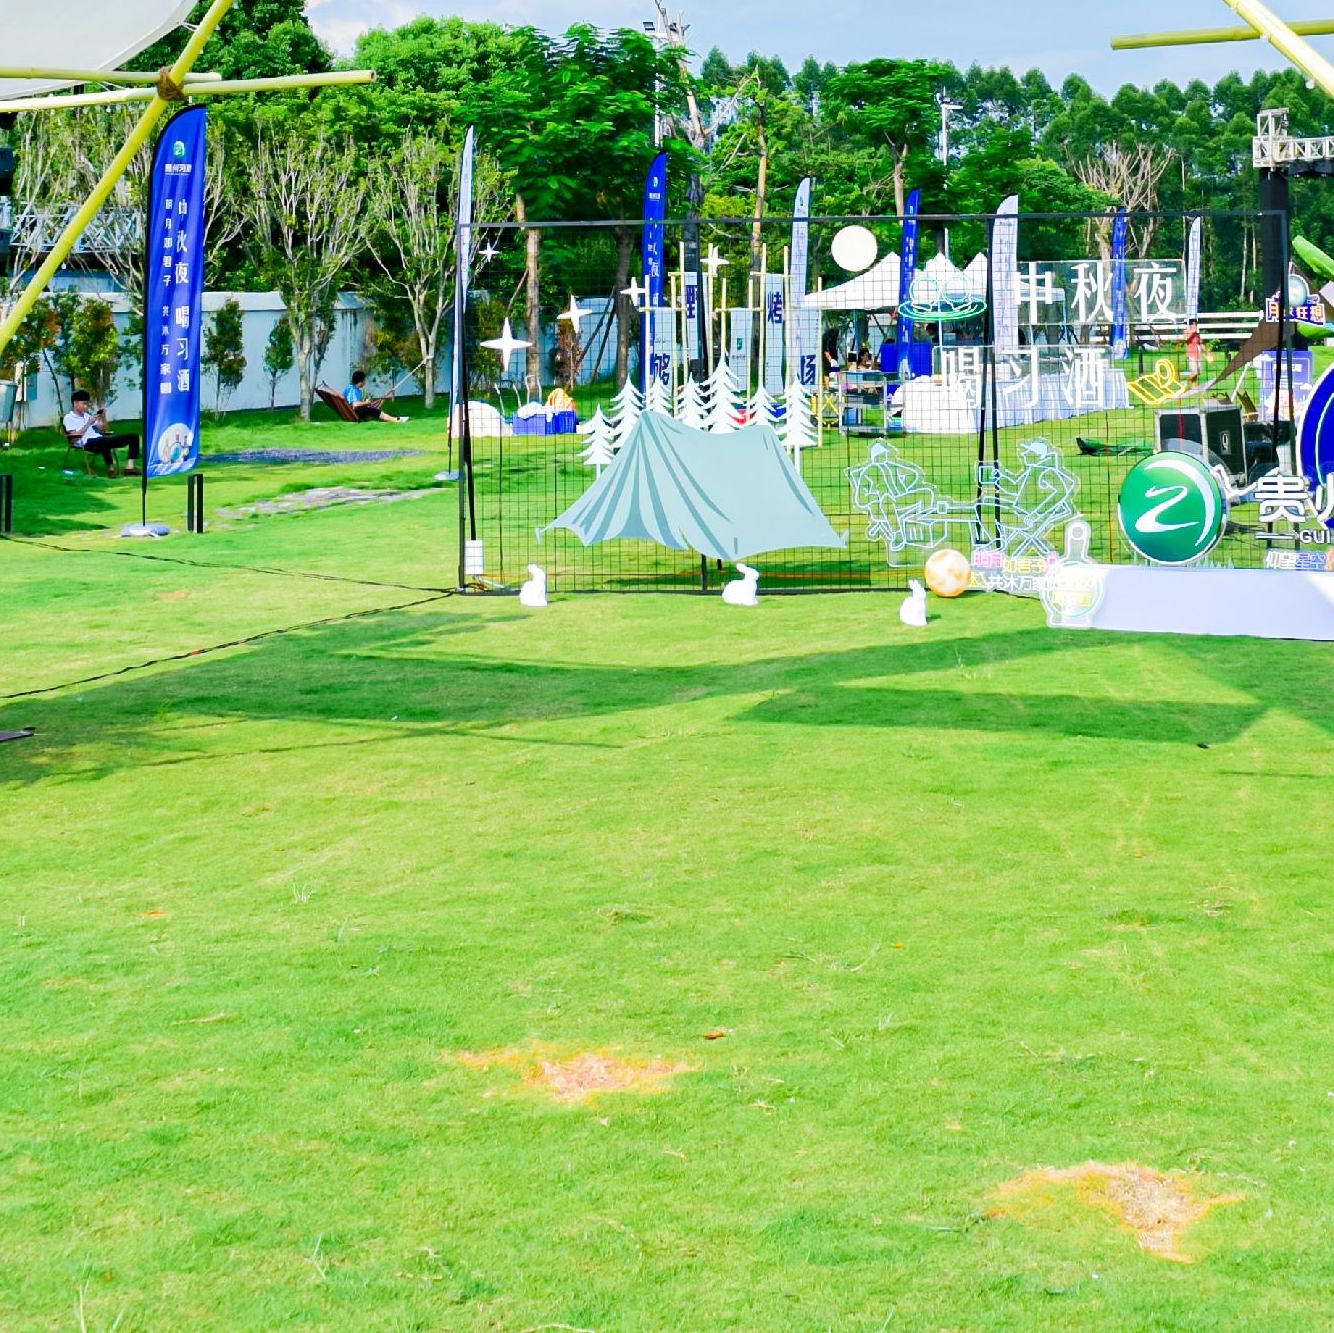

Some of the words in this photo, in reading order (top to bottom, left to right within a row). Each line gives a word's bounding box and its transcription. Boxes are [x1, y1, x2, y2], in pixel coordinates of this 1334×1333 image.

[1013, 261, 1177, 325] 中秋夜
[940, 346, 1109, 410] 喝习酒
[1299, 530, 1331, 544] GUI
